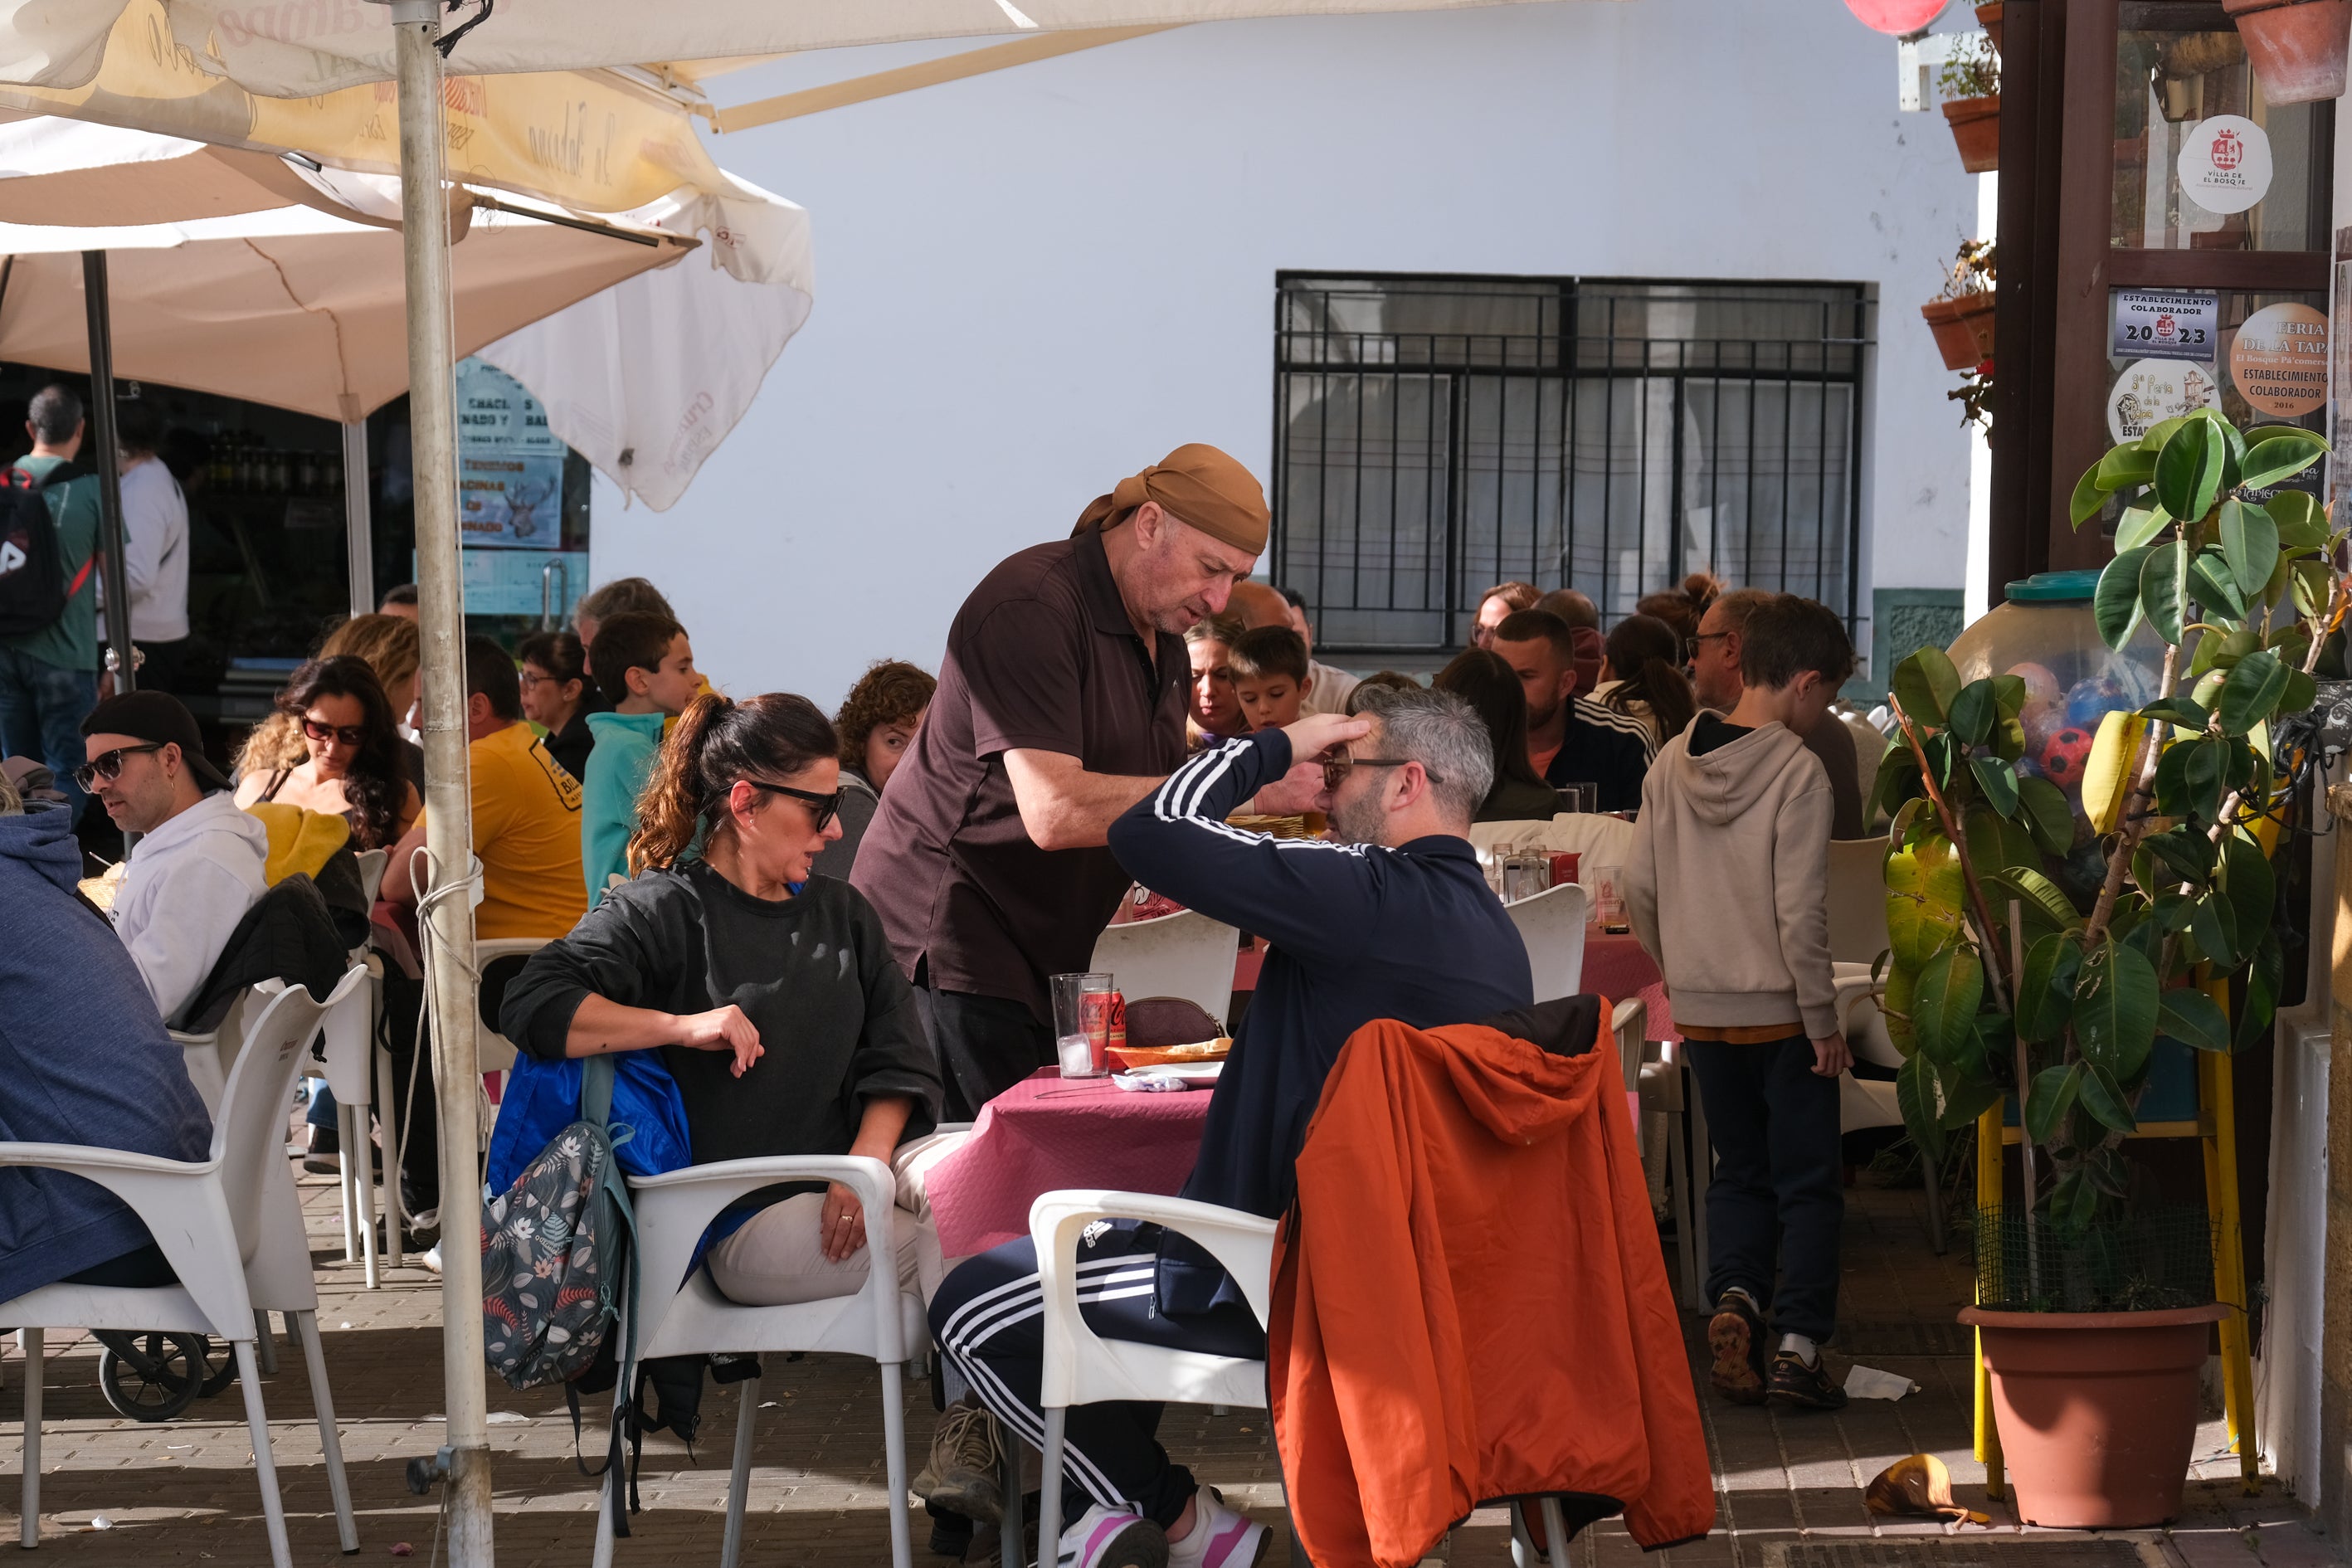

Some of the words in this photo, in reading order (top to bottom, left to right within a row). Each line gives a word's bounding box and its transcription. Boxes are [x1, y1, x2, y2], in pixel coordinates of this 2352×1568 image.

[2123, 294, 2213, 307] ESTABLECIMIENTO
[2130, 304, 2203, 316] COLABORADOR
[2277, 321, 2325, 336] FERIA
[2242, 338, 2266, 351] DE
[2247, 355, 2279, 365] Bosque
[2243, 368, 2329, 383] ESTABLECIMIENTO
[2147, 374, 2173, 395] Feria
[2249, 385, 2321, 399] COLABORADOR
[2273, 402, 2295, 410] 2016
